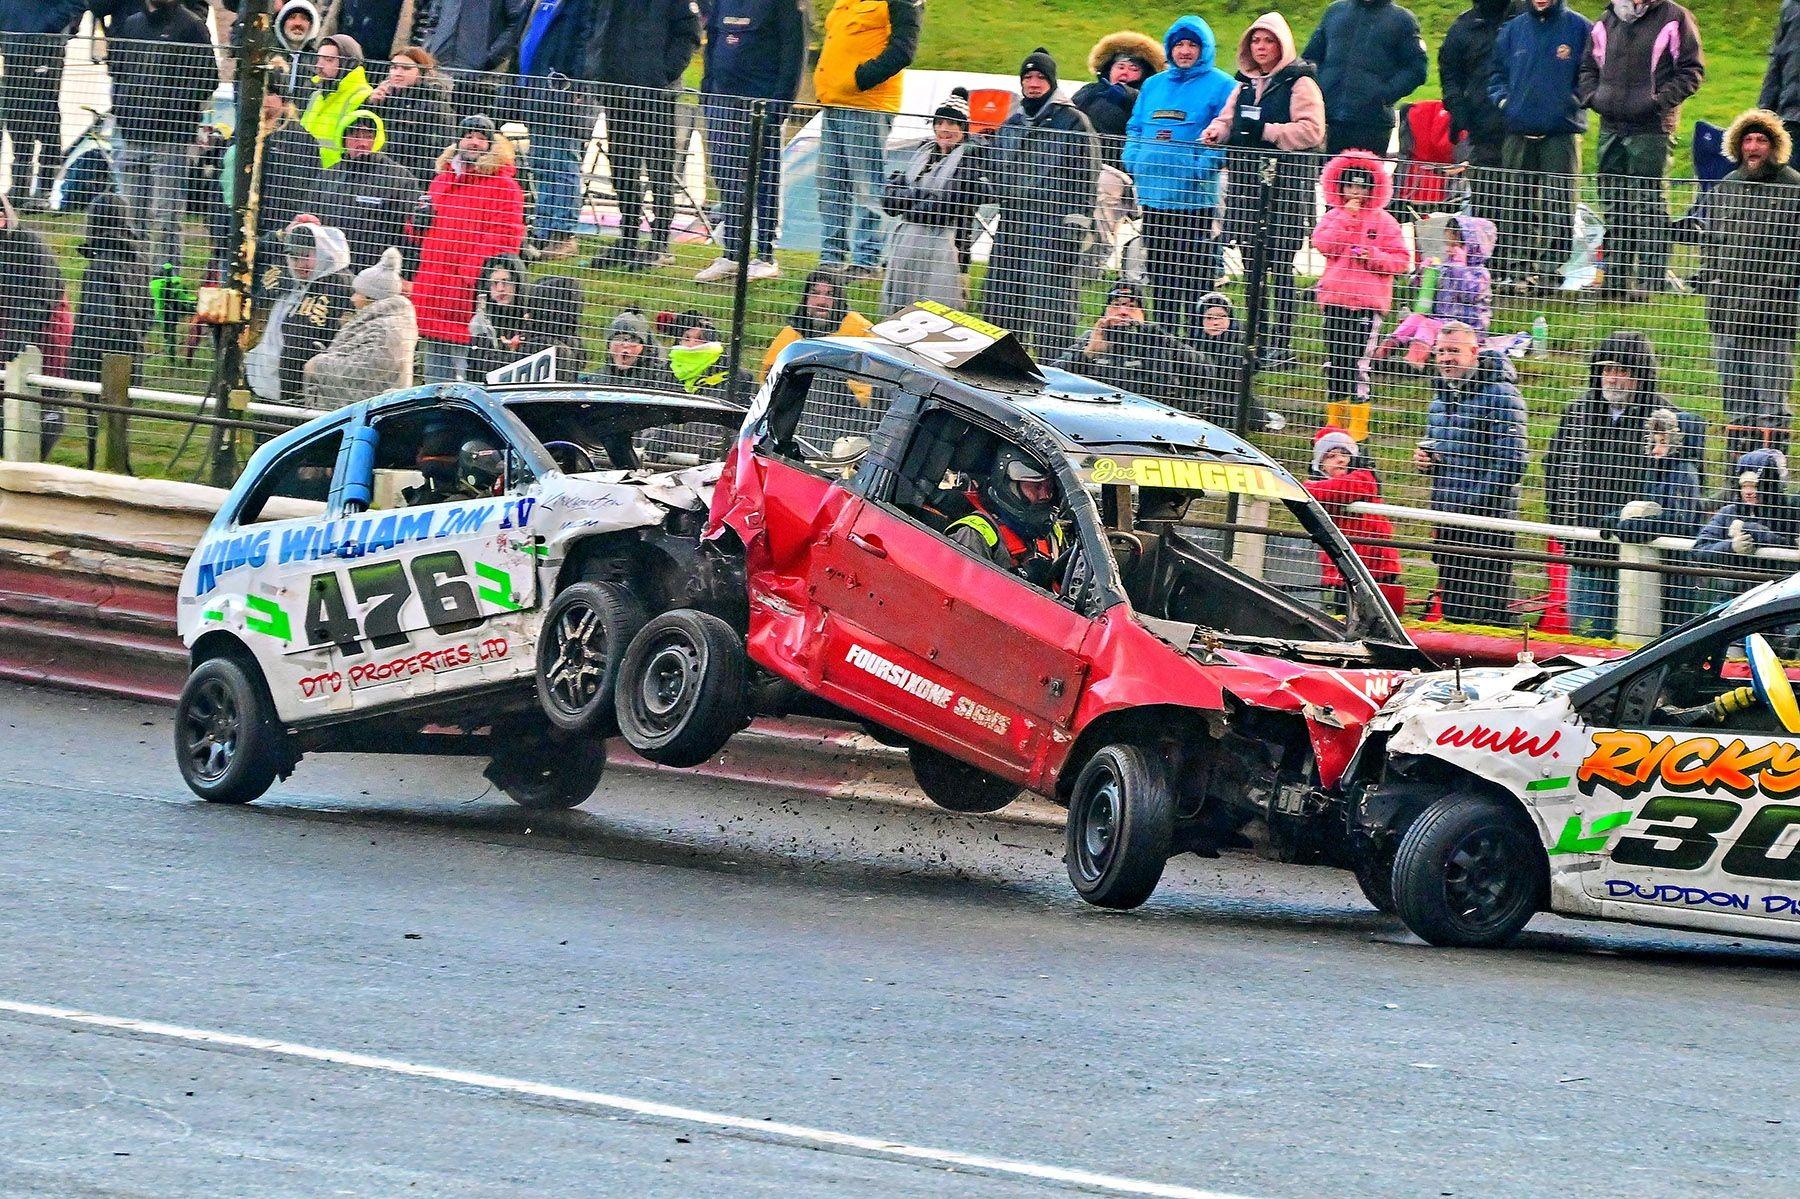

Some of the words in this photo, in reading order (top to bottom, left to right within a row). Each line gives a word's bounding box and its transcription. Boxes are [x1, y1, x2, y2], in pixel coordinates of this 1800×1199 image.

[870, 310, 997, 367] 82
[1090, 458, 1136, 484] Joe
[1133, 458, 1285, 498] GINGELL
[196, 529, 272, 596] KING
[278, 510, 435, 565] WILLIAM
[499, 498, 535, 529] IV
[304, 550, 487, 657] 476
[348, 644, 472, 687] PROPERTIES
[479, 638, 508, 661] LTD
[845, 643, 955, 709] FOURSIXONE
[1610, 796, 1800, 881] 30
[1605, 880, 1750, 910] DUDDON
